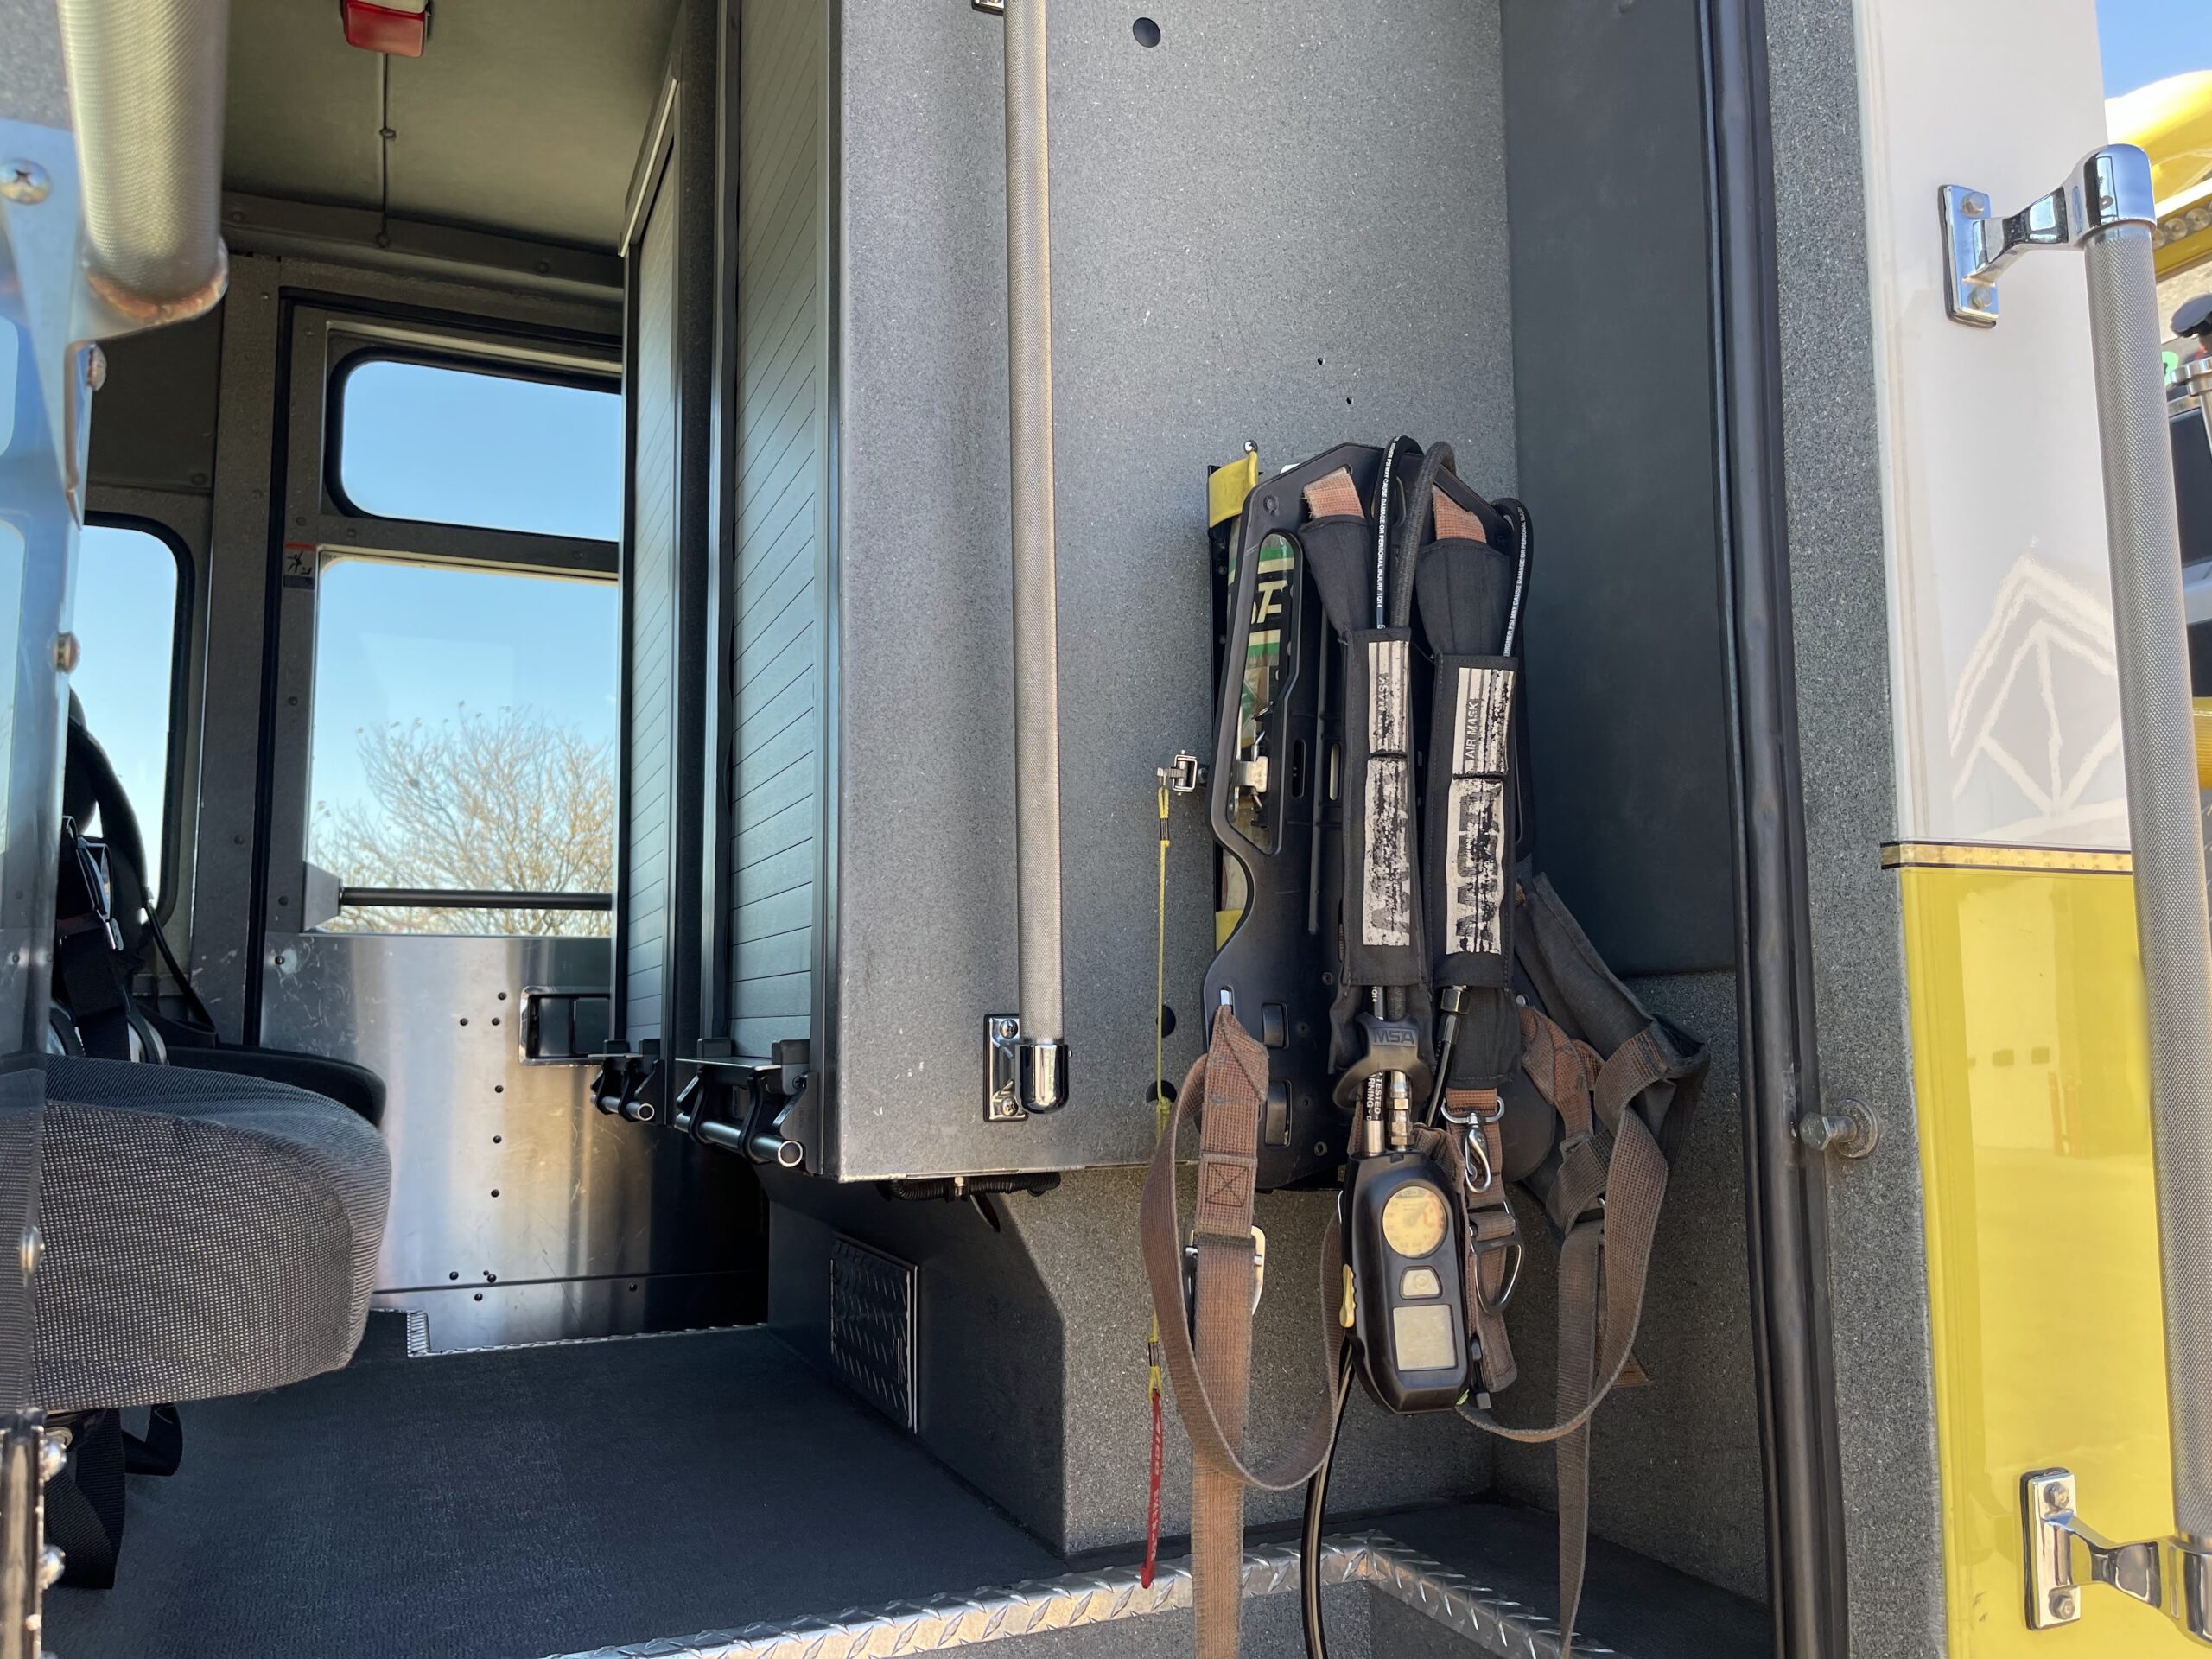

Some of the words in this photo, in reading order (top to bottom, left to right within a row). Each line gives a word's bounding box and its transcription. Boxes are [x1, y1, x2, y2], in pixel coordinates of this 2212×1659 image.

[1379, 524, 1385, 534] OR
[1513, 585, 1522, 605] CAUSE
[1466, 701, 1479, 735] MASK
[1465, 738, 1477, 759] AIR
[1373, 1030, 1414, 1045] MSA
[1366, 1074, 1376, 1108] RNING
[1374, 1077, 1382, 1114] TESTED
